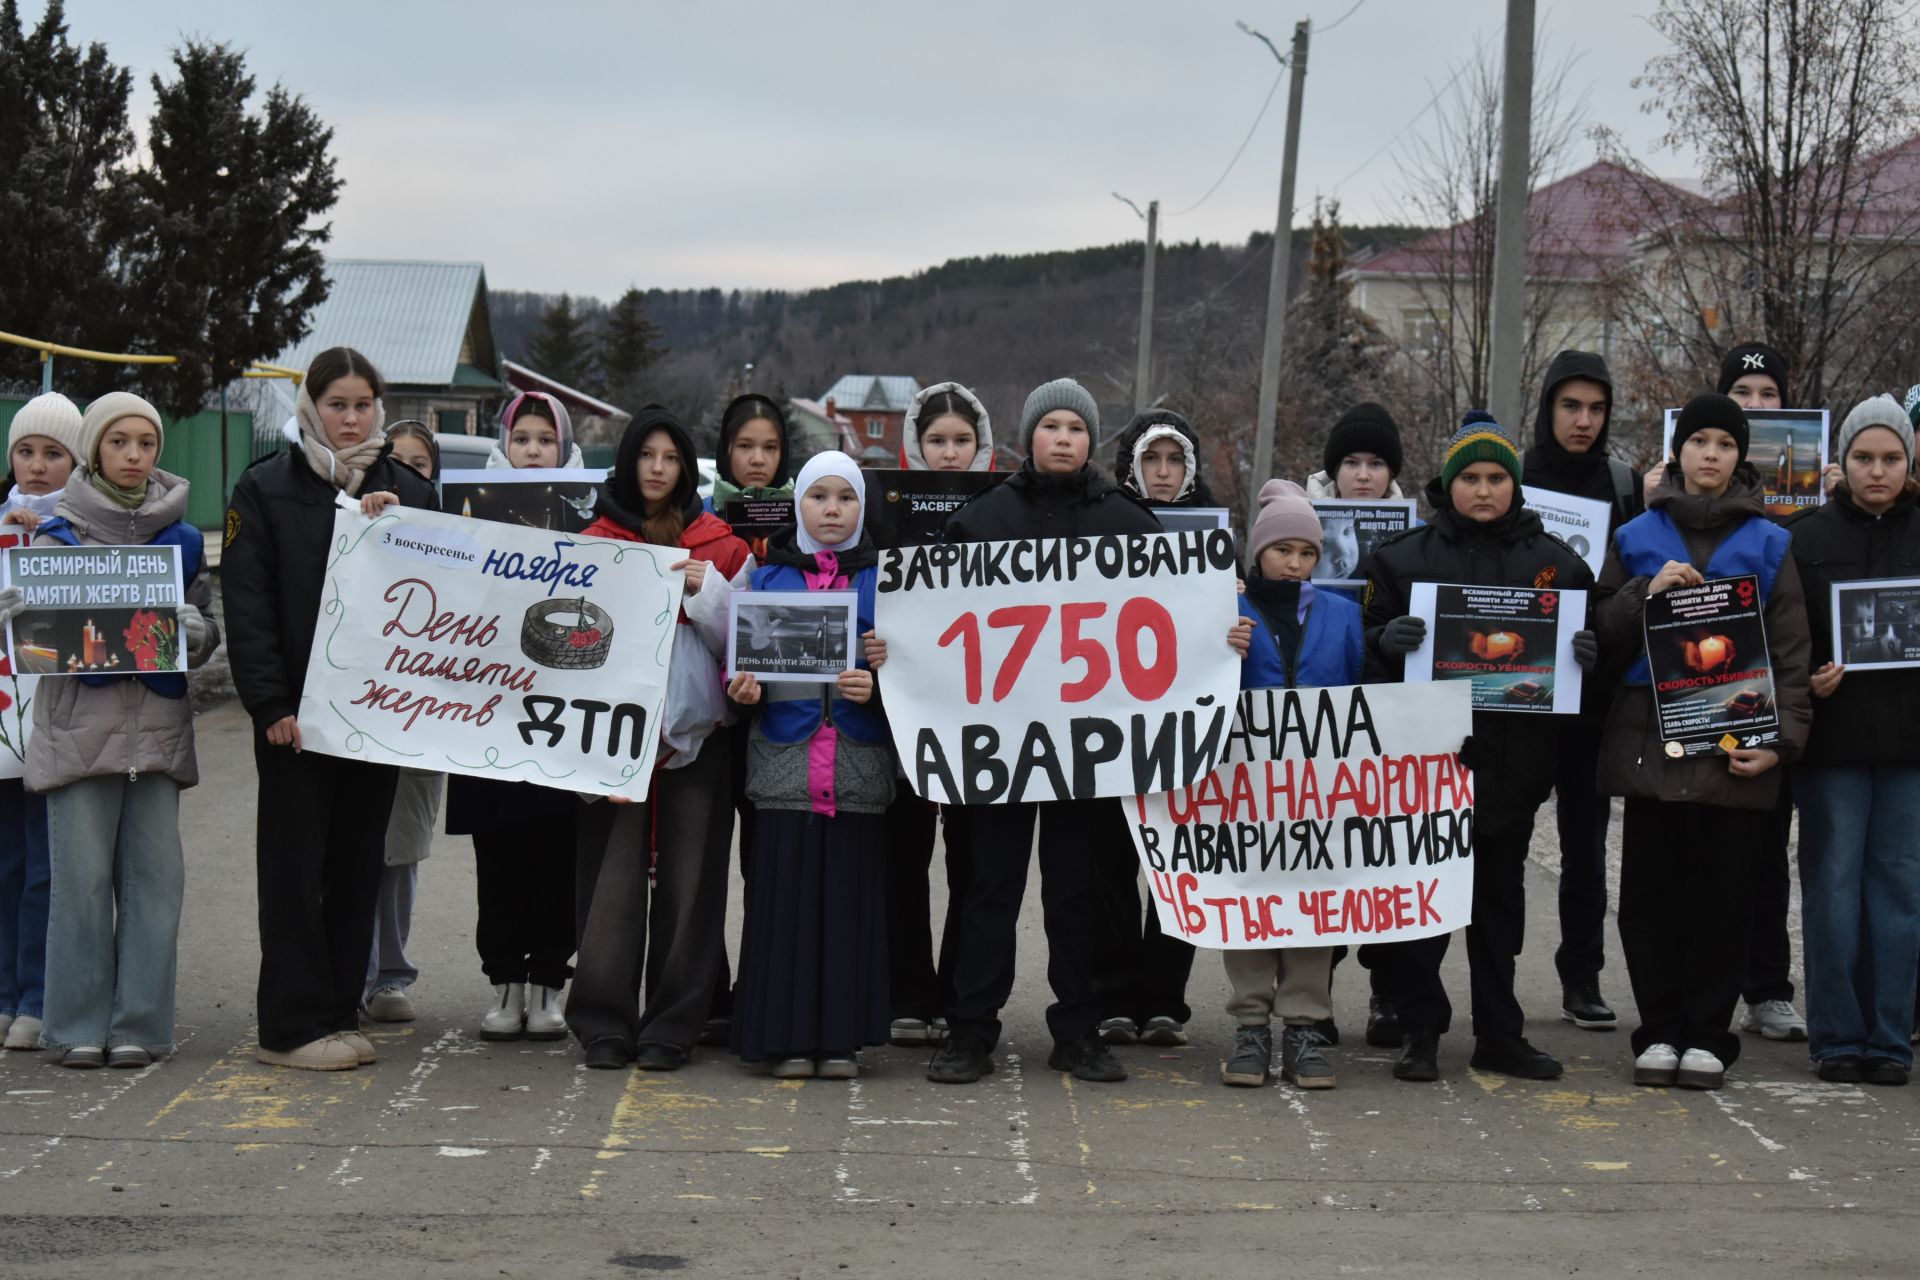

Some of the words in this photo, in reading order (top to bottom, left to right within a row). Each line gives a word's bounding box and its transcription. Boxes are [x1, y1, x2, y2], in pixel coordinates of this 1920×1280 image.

[911, 501, 961, 511] ЗАСВЕТ
[1763, 495, 1793, 505] ЕРТВ
[1796, 495, 1818, 506] ДТП
[1316, 508, 1354, 519] емирный
[1354, 509, 1374, 520] День
[1360, 521, 1387, 530] жертв
[1387, 520, 1405, 531] ДТП
[1537, 510, 1590, 528] ЕВЫШАЙ
[19, 549, 122, 577] ВСЕМИРНЫЙ
[126, 555, 168, 578] ДЕНЬ
[382, 532, 392, 545] 3
[395, 534, 476, 562] воскресенье
[481, 541, 599, 596] ноября
[877, 528, 1235, 593] ЗАФИКСИРОВАНО
[85, 583, 141, 605] ЖЕРТВ
[145, 583, 177, 607] ДТП
[1514, 590, 1536, 598] ДЕНЬ
[1671, 596, 1702, 606] ПАМЯТИ
[1704, 593, 1728, 602] ЖЕРТВ
[1712, 583, 1733, 593] ДЕНЬ
[382, 578, 500, 648] День
[1502, 597, 1529, 605] ЖЕРТВ
[737, 657, 761, 665] ДЕНЬ
[762, 658, 797, 666] ПАМЯТИ
[799, 659, 828, 667] ЖЕРТВ
[937, 597, 1178, 704] 1750
[385, 645, 537, 692] памяти
[1435, 661, 1496, 671] СКОРОСТЬ
[1657, 675, 1714, 691] СКОРОСТЬ
[350, 679, 503, 731] жертв
[517, 695, 647, 760] ДТП
[1219, 686, 1382, 763] АЧАЛА
[915, 694, 1226, 805] АВАРИЙ
[1265, 758, 1324, 822] НА
[1326, 752, 1474, 819] ДОРОГАХ
[1138, 823, 1166, 872] В
[1171, 819, 1334, 874] АВАРИЯХ
[1203, 894, 1294, 943] ТЫС.
[1299, 878, 1442, 936] ЧЕЛОВЕК
